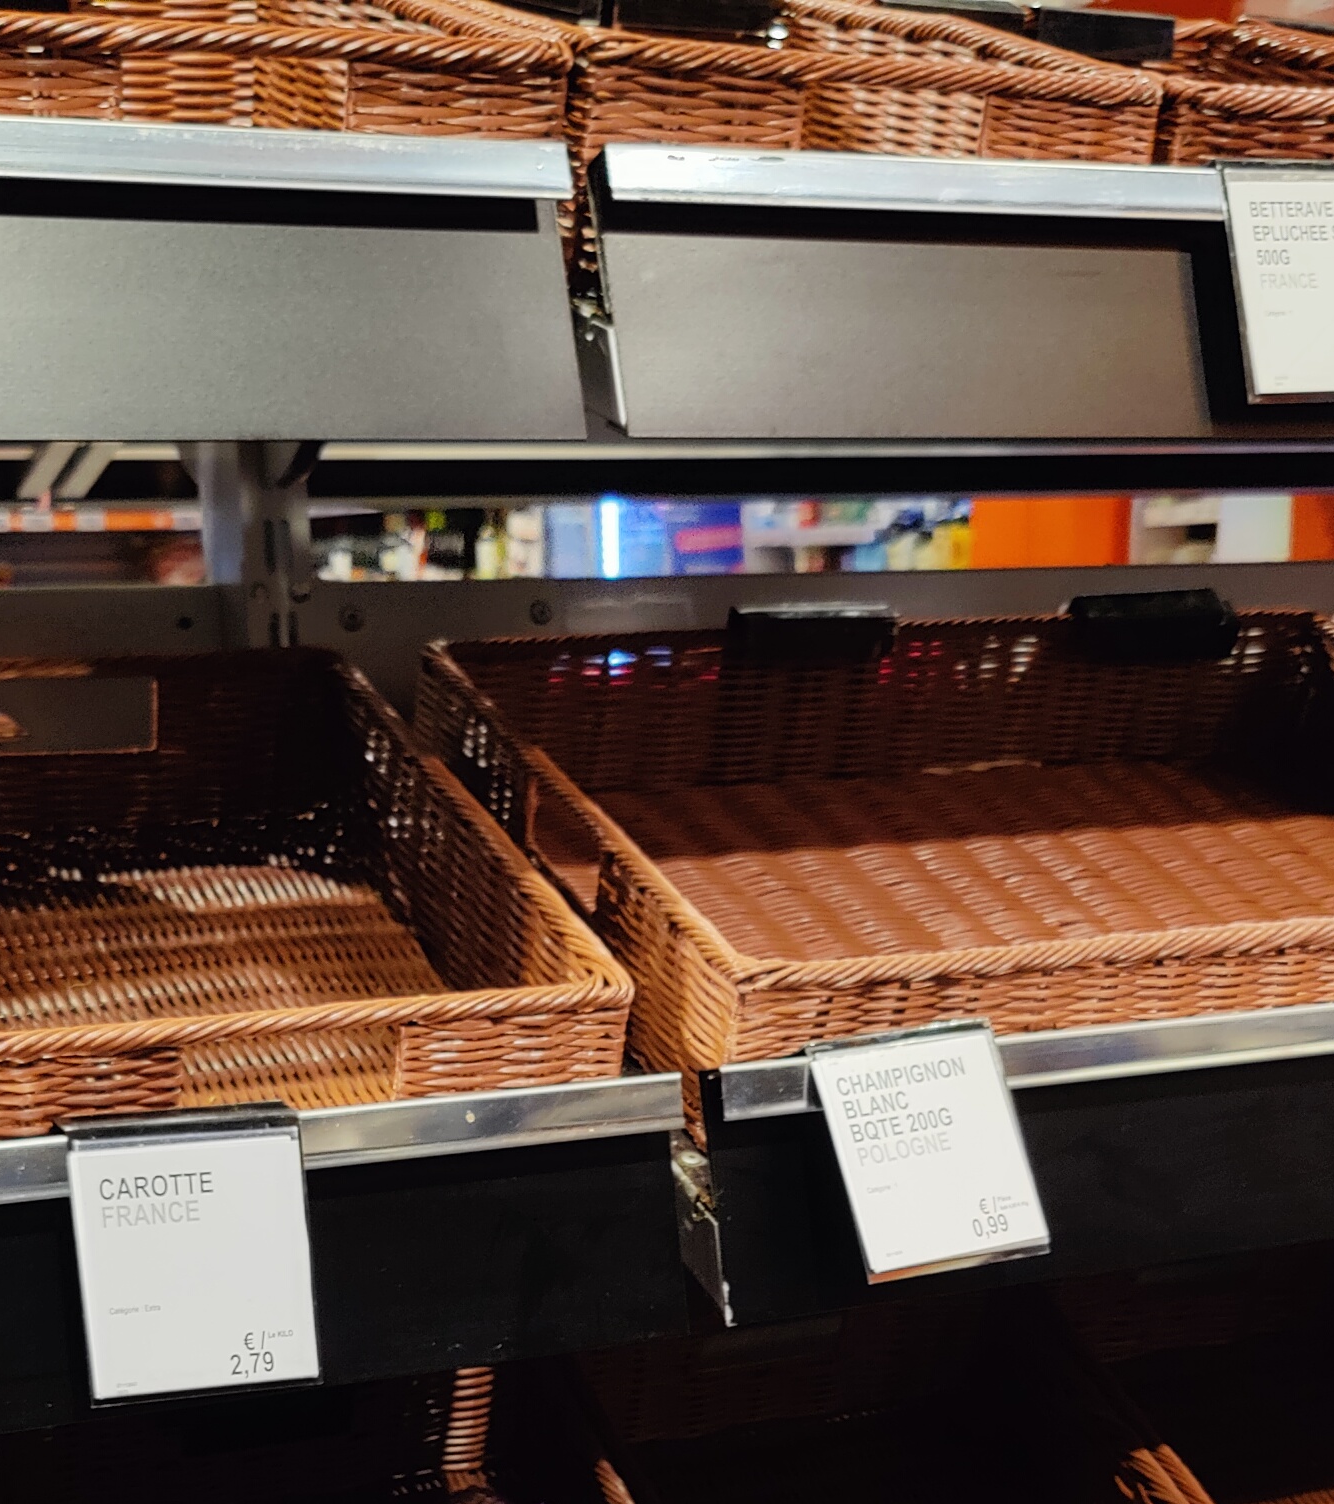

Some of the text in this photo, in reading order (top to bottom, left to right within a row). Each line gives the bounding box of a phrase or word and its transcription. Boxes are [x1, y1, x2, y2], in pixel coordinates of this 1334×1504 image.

[1249, 201, 1334, 218] BETTERAVE
[1253, 225, 1329, 241] EPLUCHEE
[1256, 249, 1290, 266] 500G
[1260, 273, 1318, 290] FRANCE
[836, 1056, 967, 1096] CHAMPIGNON
[842, 1091, 909, 1120] BLANC
[849, 1107, 953, 1144] BQTE 200G
[857, 1131, 952, 1167] POLOGNE
[99, 1171, 214, 1201] CAROTTE
[102, 1200, 200, 1228] FRANCE
[972, 1213, 1008, 1239] 0,99
[230, 1351, 274, 1378] 2,79
